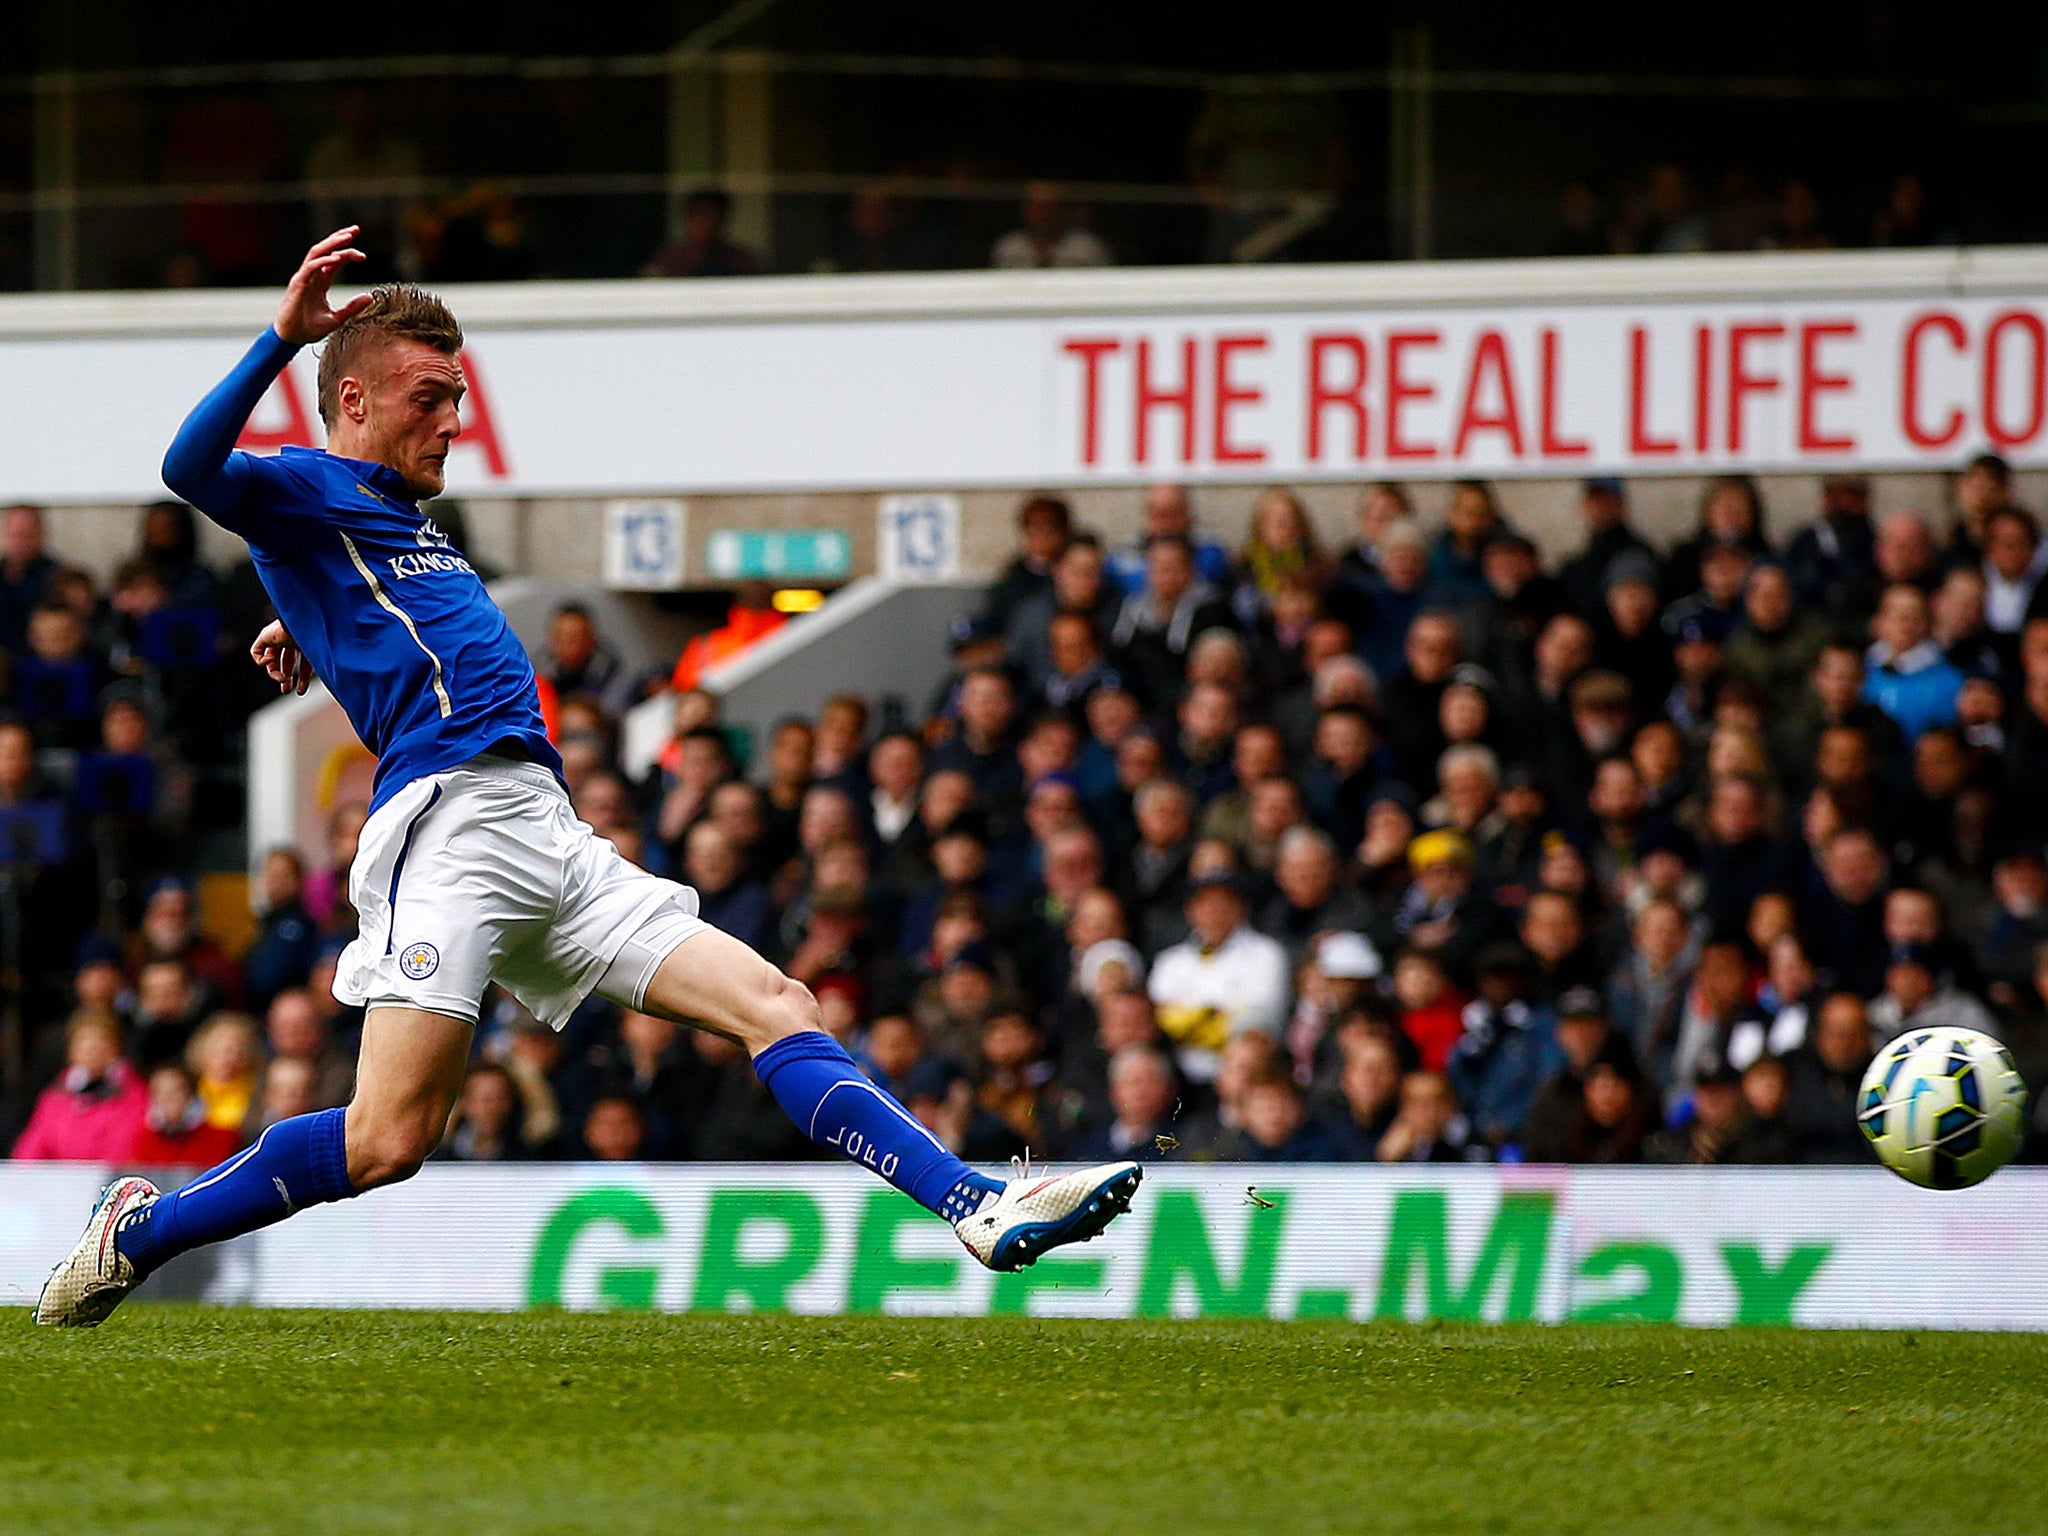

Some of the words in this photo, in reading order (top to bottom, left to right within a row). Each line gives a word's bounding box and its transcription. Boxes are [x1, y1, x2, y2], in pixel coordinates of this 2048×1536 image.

[1062, 335, 1269, 465] THE
[1306, 330, 1591, 461] REAL
[1627, 320, 1858, 456] LIFE
[1900, 310, 2048, 450] CO
[826, 1126, 900, 1178] LCFC
